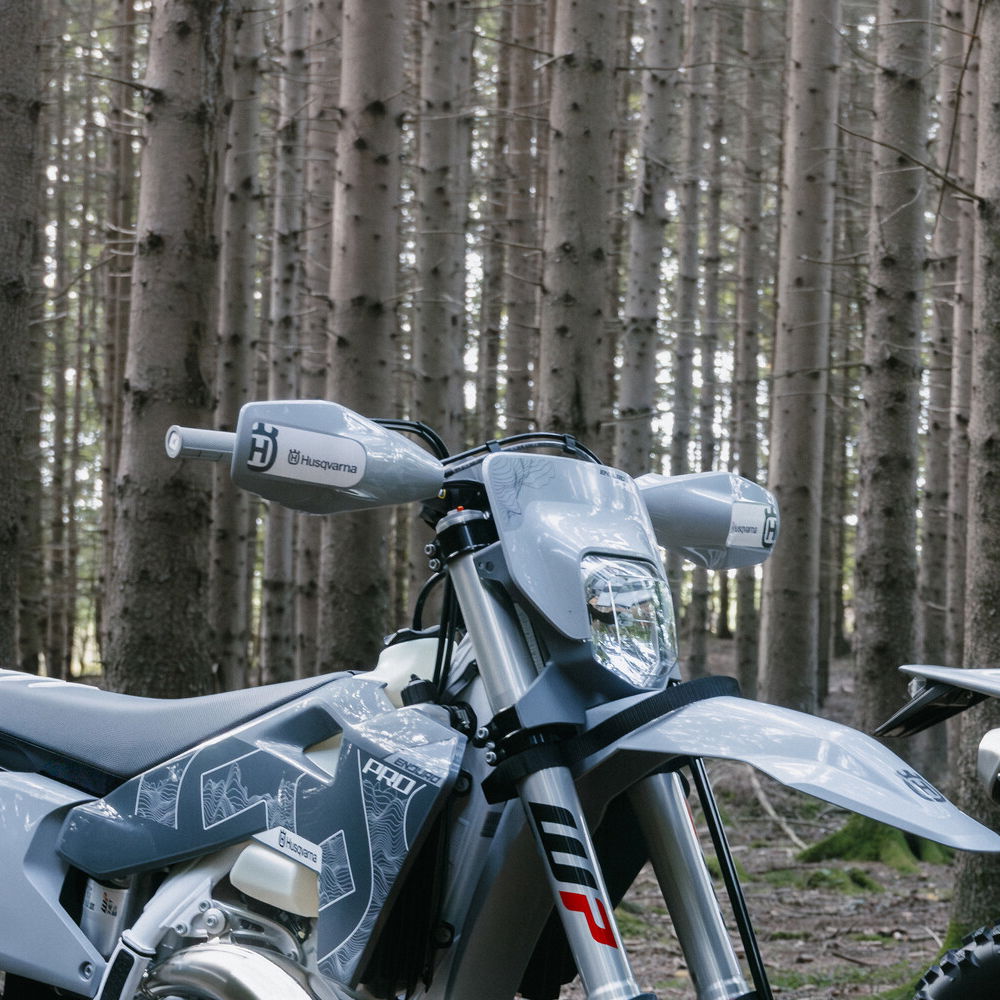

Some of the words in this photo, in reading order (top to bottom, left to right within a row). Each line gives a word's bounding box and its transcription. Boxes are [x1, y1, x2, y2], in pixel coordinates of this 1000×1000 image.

[300, 453, 358, 475] Husqvarna
[361, 757, 417, 796] PRO
[394, 757, 442, 784] ENDURO
